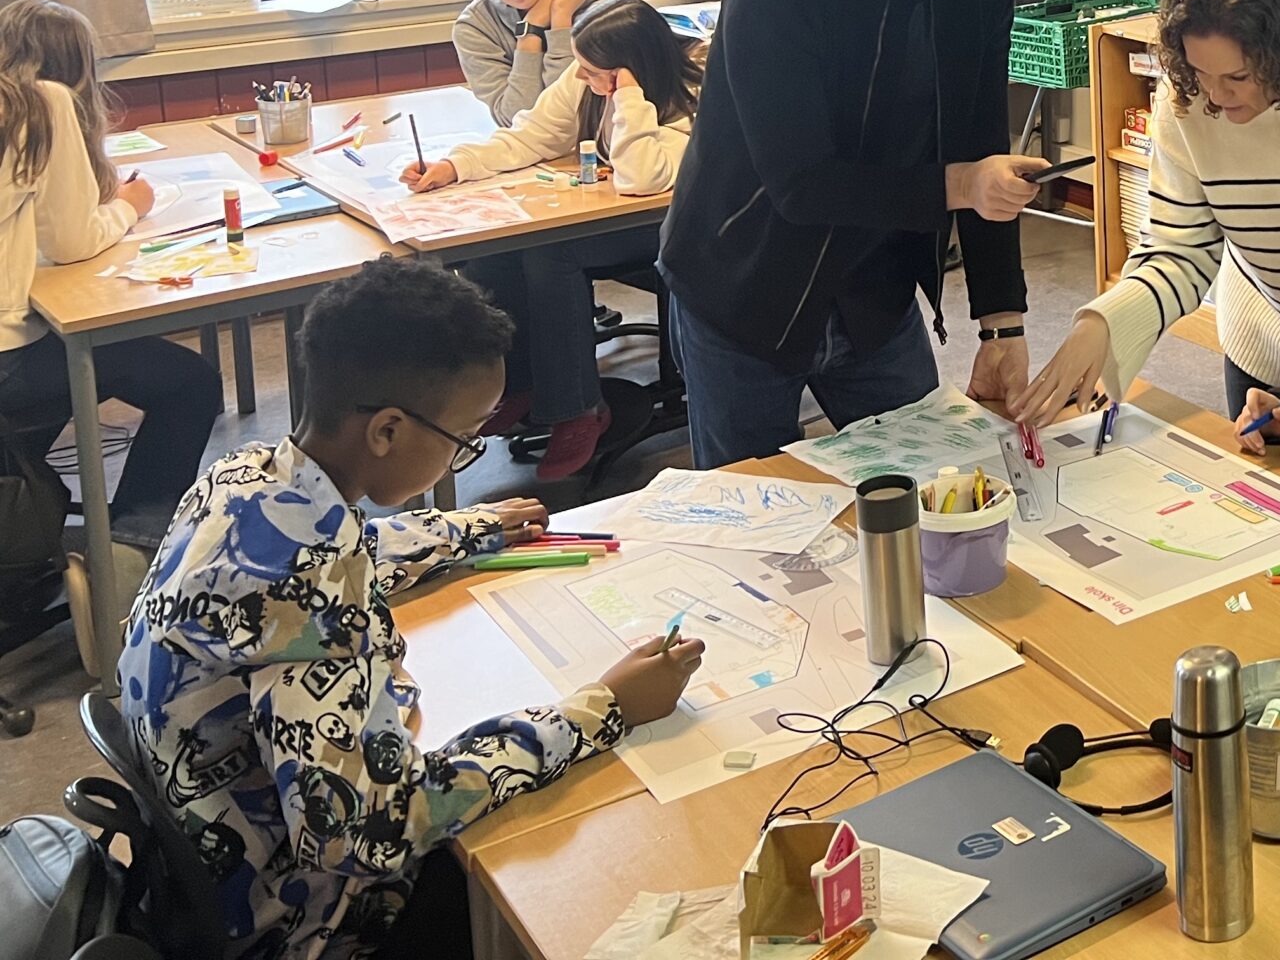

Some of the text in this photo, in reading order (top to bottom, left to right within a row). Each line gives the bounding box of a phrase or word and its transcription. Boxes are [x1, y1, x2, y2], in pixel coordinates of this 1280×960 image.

[1084, 586, 1134, 615] Din skole
[959, 835, 1002, 859] hp
[862, 860, 878, 910] 10 03 24
